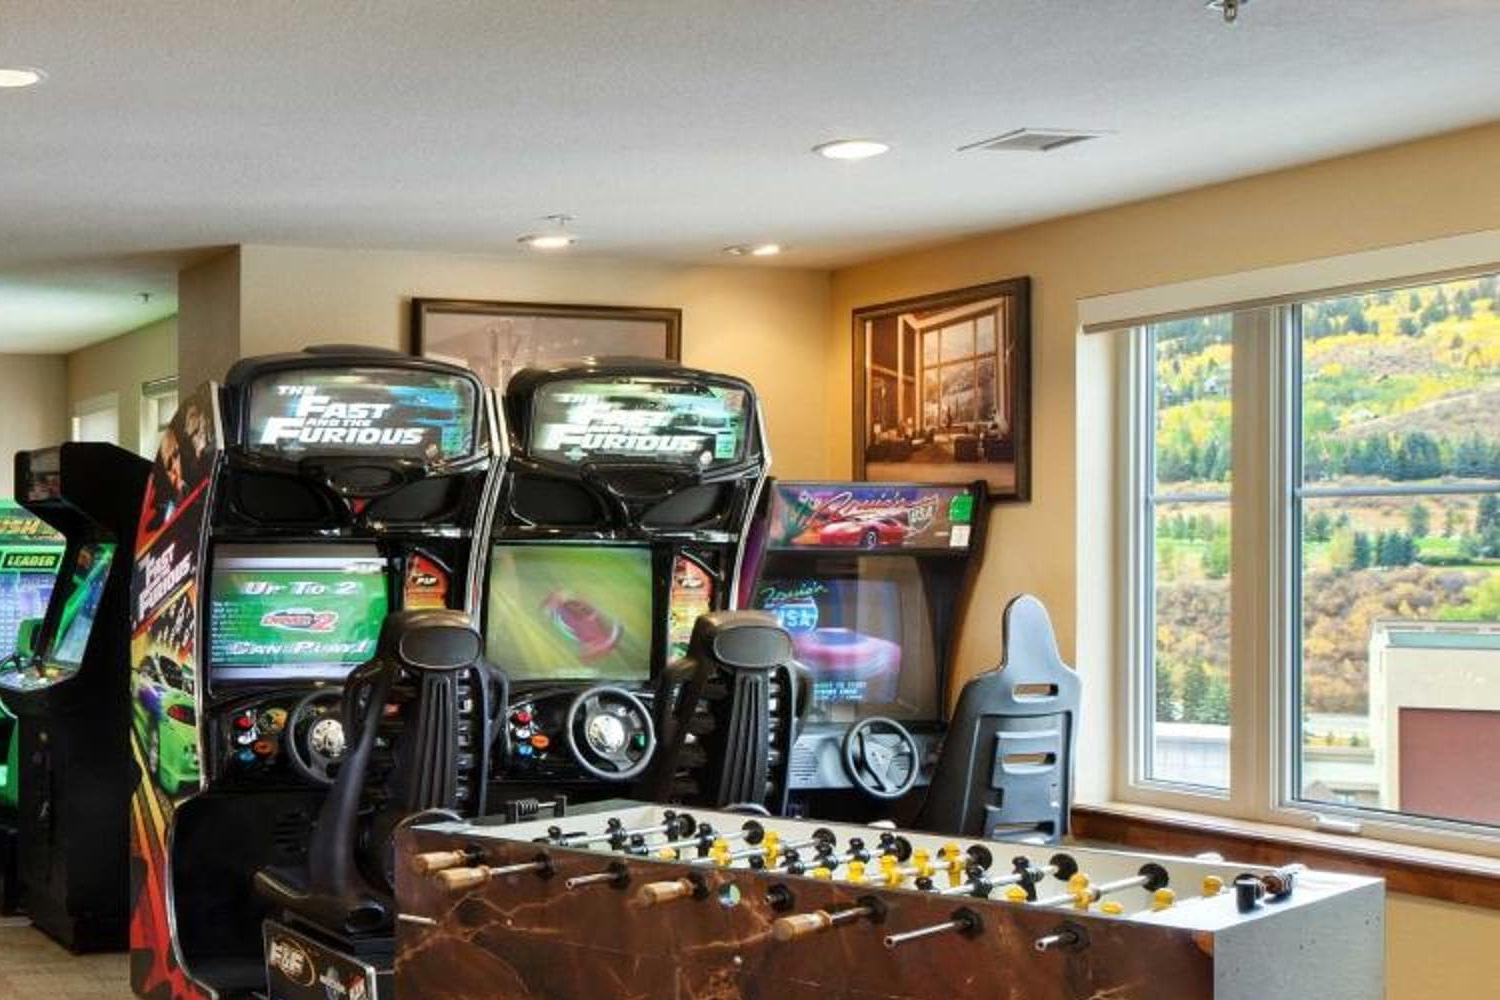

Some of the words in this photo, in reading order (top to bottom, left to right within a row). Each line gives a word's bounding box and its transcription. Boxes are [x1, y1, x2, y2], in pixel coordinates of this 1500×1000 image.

[276, 384, 318, 396] THE
[296, 395, 392, 419] FAST
[260, 416, 427, 445] FURIOUS
[305, 418, 339, 427] AND
[341, 418, 372, 427] THE
[542, 424, 703, 451] FURIOUS
[7, 554, 56, 567] LEADER
